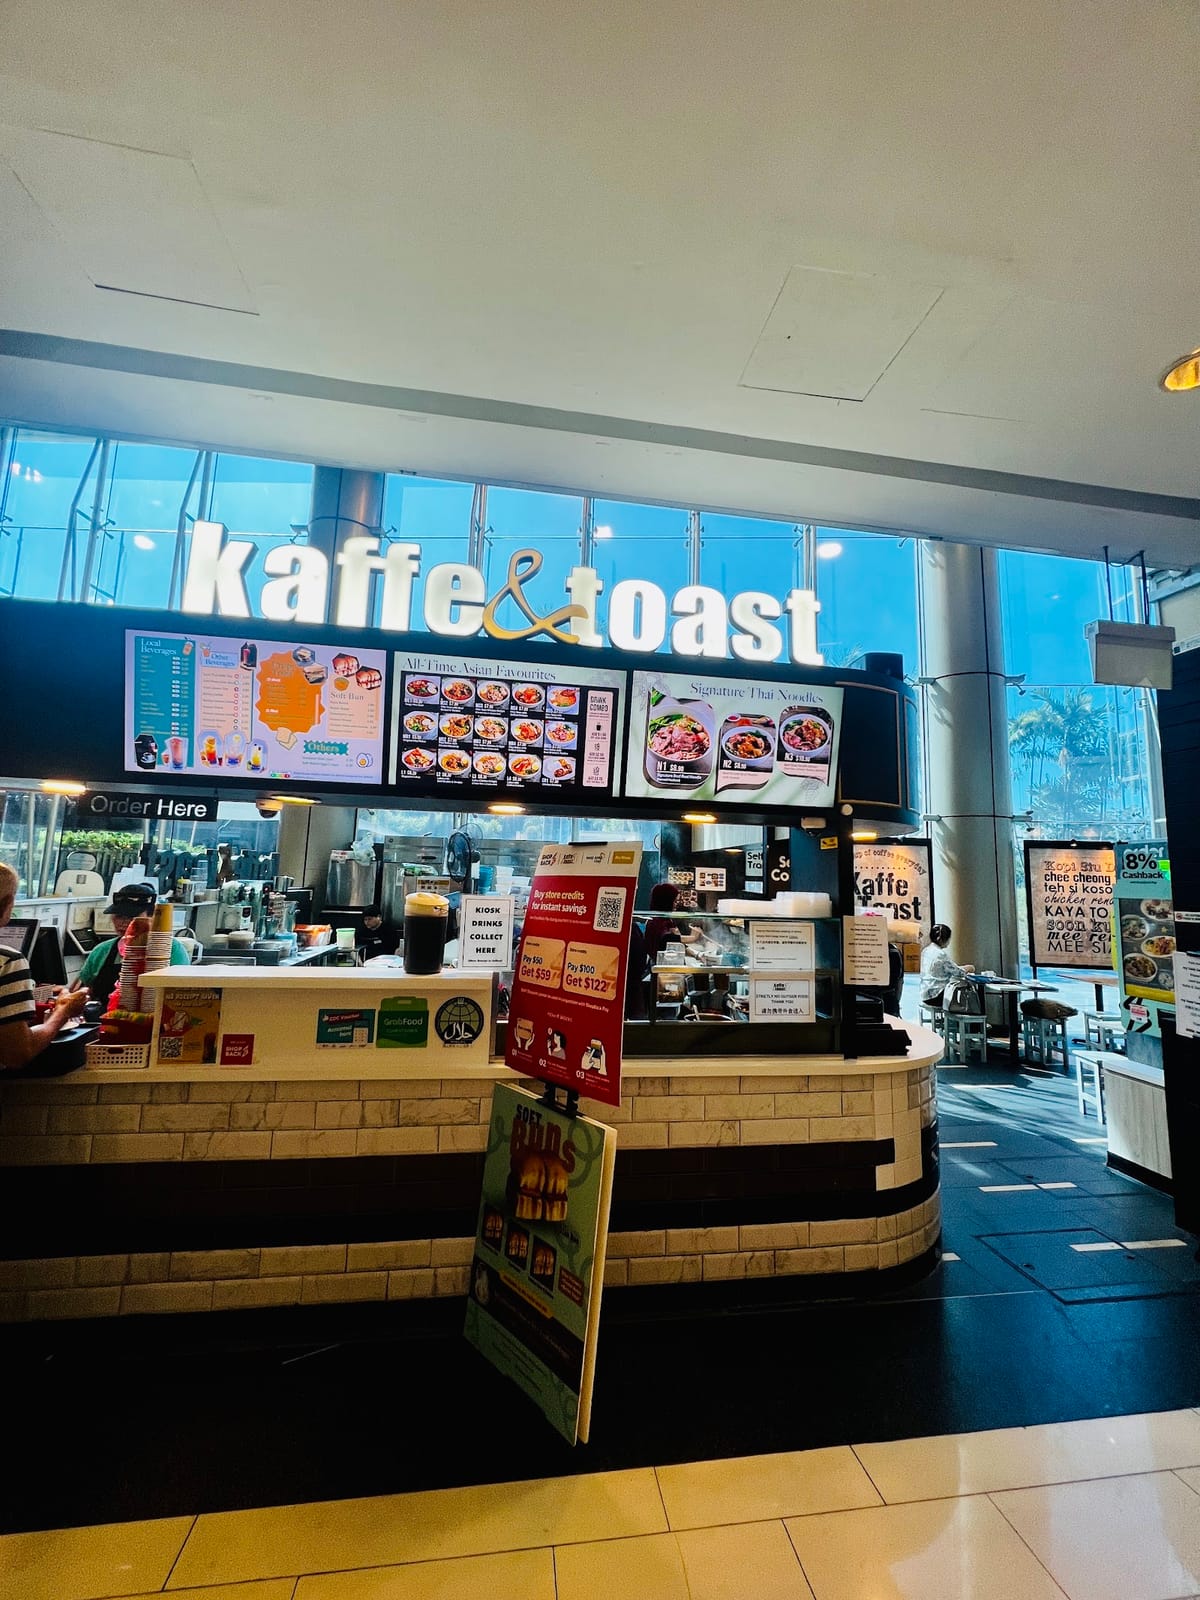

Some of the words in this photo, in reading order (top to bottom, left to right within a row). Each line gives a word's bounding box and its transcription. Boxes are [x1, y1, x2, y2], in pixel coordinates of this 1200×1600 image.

[181, 520, 486, 637] kaffe
[482, 547, 589, 644] &
[565, 566, 825, 667] toast
[141, 638, 161, 647] Local
[141, 645, 177, 656] Beverages
[403, 658, 457, 674] All-Time
[459, 662, 492, 677] Asian
[496, 665, 556, 681] Favourites
[331, 691, 346, 700] Soft
[348, 692, 364, 701] Bun
[690, 682, 745, 698] Signature
[749, 686, 775, 701] Thai
[778, 689, 824, 704] Noodles
[308, 741, 340, 753] Others
[657, 761, 667, 772] N1
[722, 759, 733, 769] N2
[90, 795, 152, 815] Order
[157, 799, 208, 818] Here
[873, 849, 895, 859] coffee
[895, 853, 927, 876] everyday
[1044, 860, 1077, 874] Kopi
[1044, 872, 1070, 882] chee
[1073, 872, 1111, 886] cheong
[1122, 871, 1164, 879] Cashback
[1044, 882, 1065, 893] teh
[1069, 882, 1078, 894] si
[1082, 884, 1113, 894] koso
[534, 889, 545, 901] Buy
[545, 890, 561, 900] store
[561, 890, 585, 901] credits
[1044, 891, 1087, 905] chicken
[531, 901, 540, 911] for
[540, 902, 561, 912] instant
[561, 902, 588, 916] savings
[1045, 905, 1086, 918] KAYA
[1089, 906, 1109, 919] TO
[1046, 919, 1087, 932] soon
[470, 933, 504, 941] COLLECT
[1047, 931, 1083, 941] mee
[1047, 940, 1084, 953] MEE
[523, 954, 533, 965] Pay
[521, 965, 535, 977] Get
[535, 967, 552, 981] $59
[567, 962, 578, 973] Pay
[579, 964, 595, 975] $100
[566, 974, 583, 988] Get
[583, 976, 608, 993] $122
[383, 1017, 424, 1026] GrabFood
[538, 1058, 547, 1068] 02
[575, 1070, 585, 1079] 03
[516, 1103, 543, 1126] SOFT
